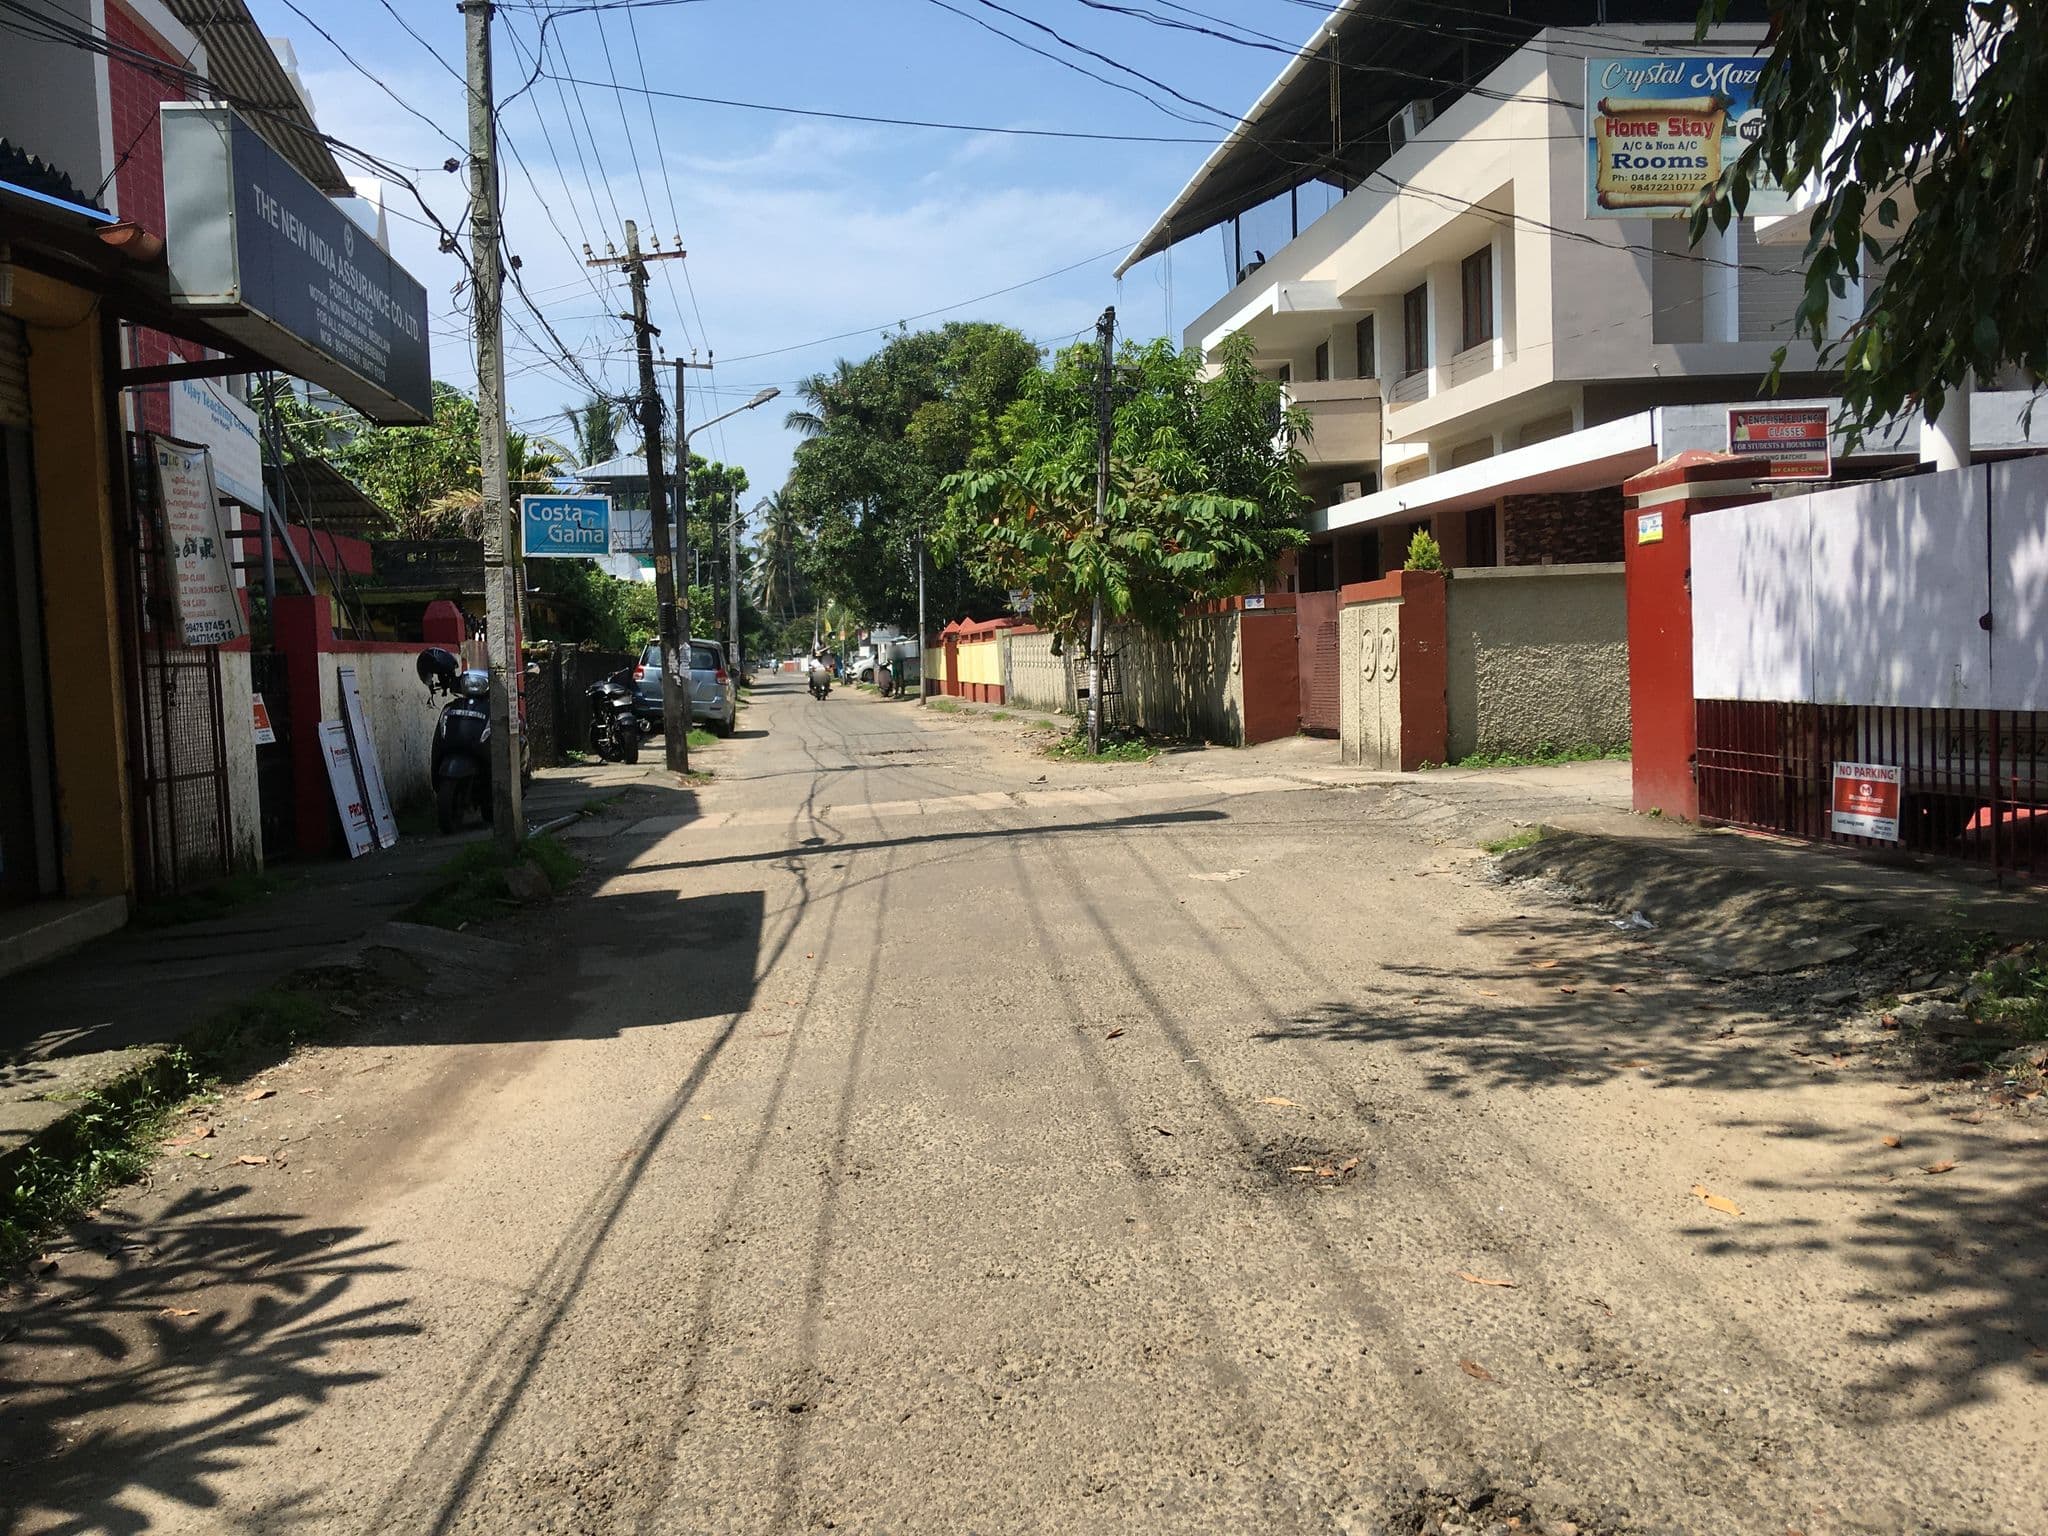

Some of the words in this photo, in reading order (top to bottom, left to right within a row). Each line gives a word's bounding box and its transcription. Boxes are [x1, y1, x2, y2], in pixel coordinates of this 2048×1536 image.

[1600, 62, 1685, 93] Crystal
[1605, 116, 1660, 137] Home
[1667, 116, 1715, 140] Stay
[1622, 141, 1642, 152] A/C
[1645, 142, 1653, 151] &
[1656, 141, 1675, 150] Non
[1678, 141, 1698, 152] A/C
[1611, 153, 1709, 169] Rooms
[1612, 174, 1628, 182] Ph:
[1631, 173, 1658, 181] 0484
[1661, 173, 1707, 181] 2217122
[1630, 183, 1696, 192] 9847221077
[253, 184, 279, 230] THE
[281, 206, 307, 251] NEW
[309, 229, 337, 275] INDIA
[338, 255, 390, 319] ASSURANCE
[1748, 414, 1783, 425] ENGLISH
[1786, 413, 1825, 424] FLUENCY
[1768, 426, 1806, 438] CLASSES
[1748, 441, 1780, 450] STUDENTS
[1780, 453, 1807, 461] BATCHES
[528, 502, 582, 521] Costa
[548, 524, 604, 543] Gama
[1839, 766, 1852, 775] NO
[1854, 767, 1894, 780] PARKING
